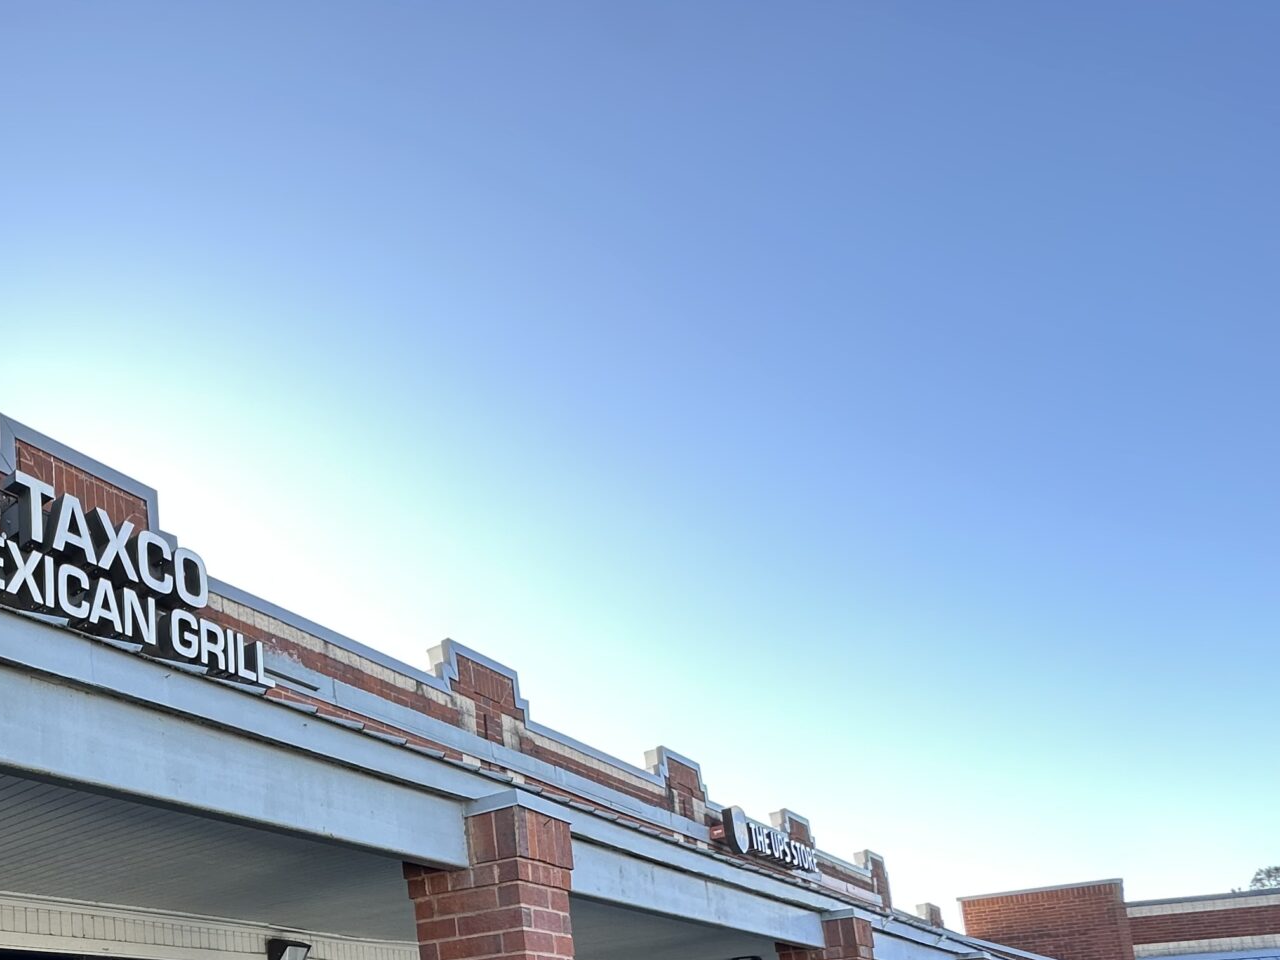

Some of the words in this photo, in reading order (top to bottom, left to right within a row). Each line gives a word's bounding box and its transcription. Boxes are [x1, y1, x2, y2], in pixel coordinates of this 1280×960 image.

[15, 470, 208, 608] TAXCO
[171, 609, 276, 688] GRILL
[749, 823, 772, 855] THE
[770, 831, 792, 862] UPS
[791, 840, 819, 873] STORE
